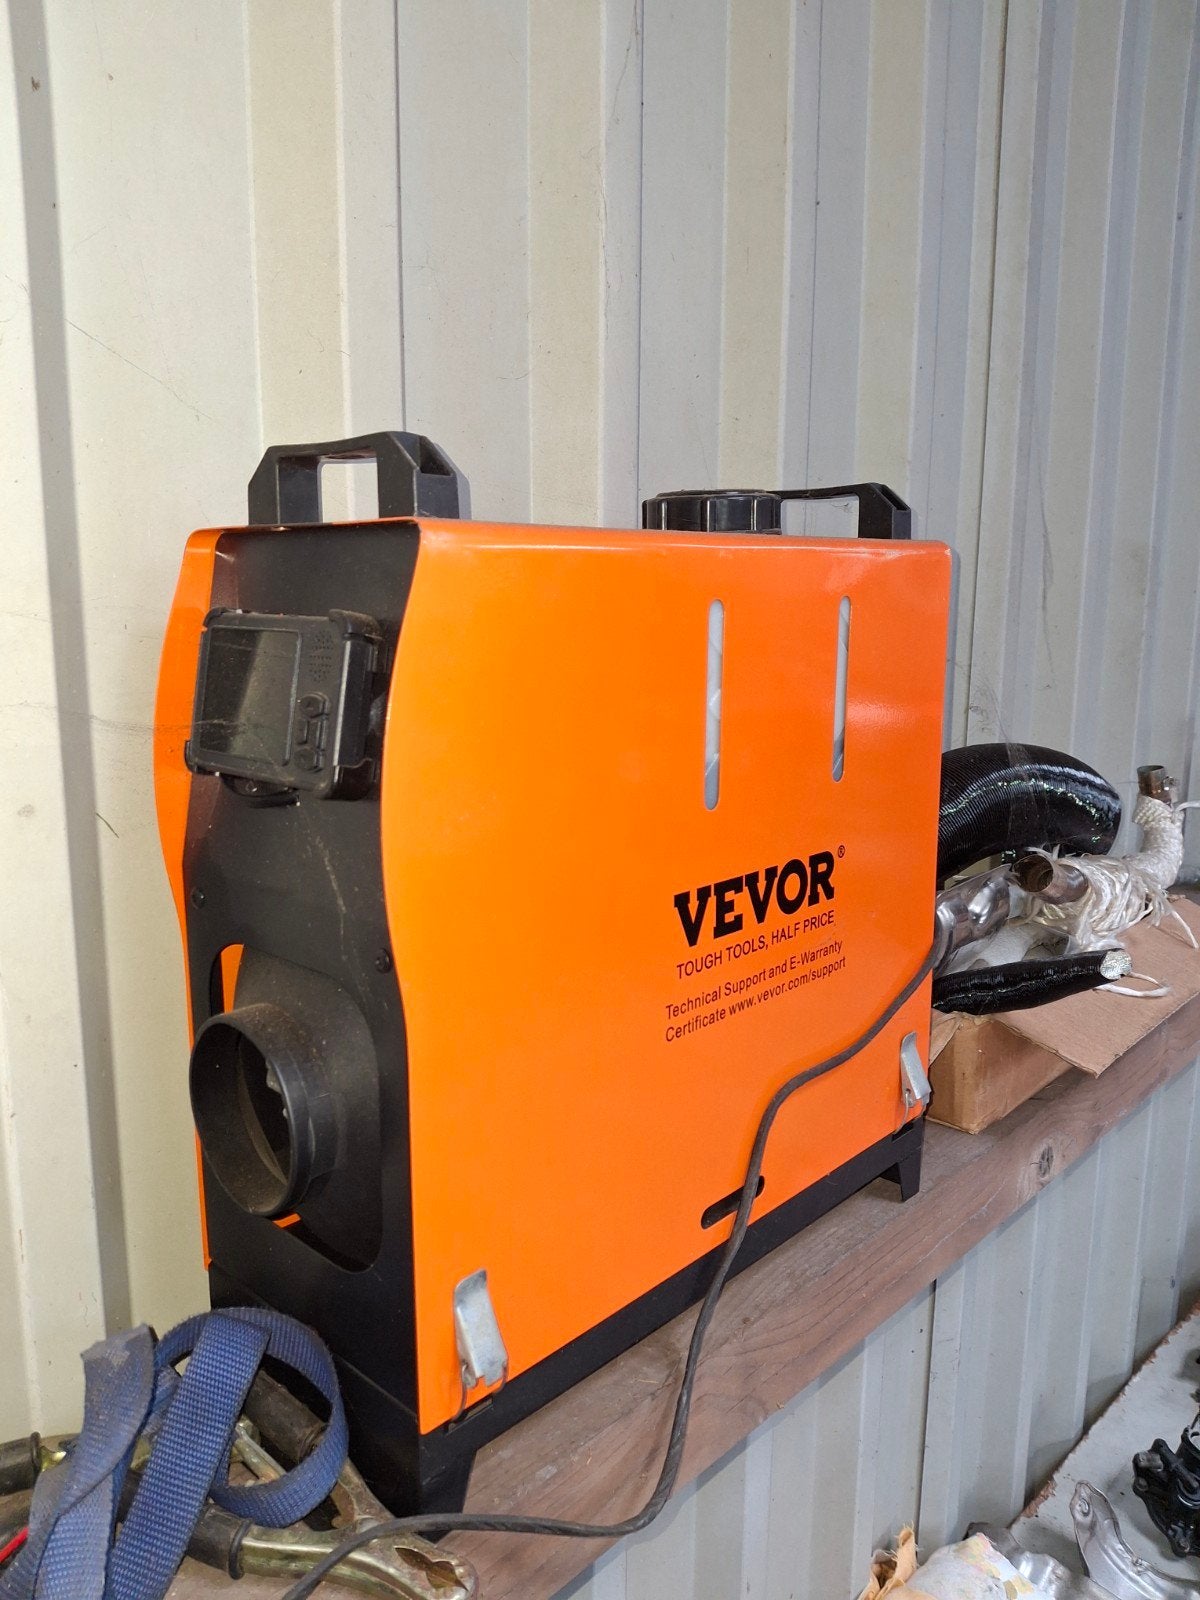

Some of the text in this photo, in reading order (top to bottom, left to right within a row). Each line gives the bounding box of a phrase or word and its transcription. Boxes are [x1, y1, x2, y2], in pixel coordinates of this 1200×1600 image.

[665, 939, 843, 1020] Technical Support and E-Warranty
[676, 910, 835, 979] TOUGH TOOLS, HALF PRICE
[665, 956, 846, 1042] Certificate www.vevor.com/support
